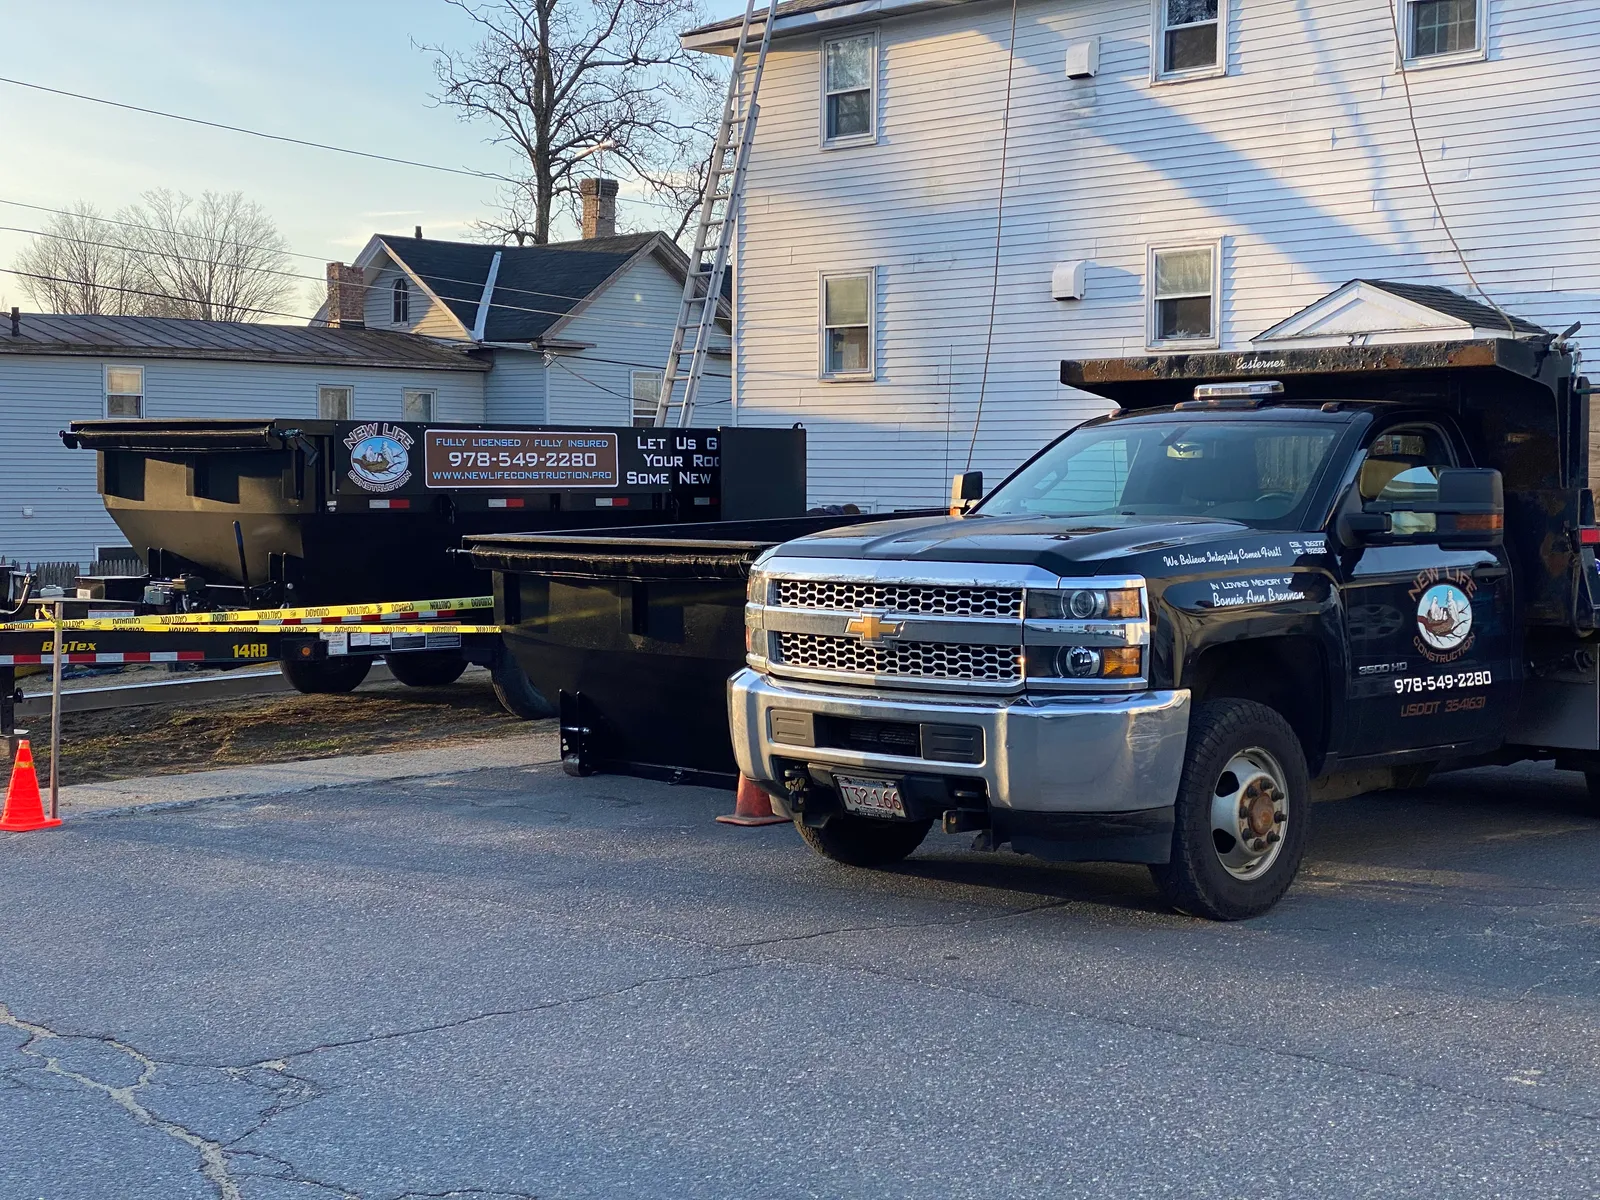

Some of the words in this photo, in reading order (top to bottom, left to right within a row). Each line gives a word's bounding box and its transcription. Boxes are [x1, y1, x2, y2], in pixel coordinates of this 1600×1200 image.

[1236, 356, 1286, 370] Easterner
[343, 422, 379, 451] NEW
[382, 423, 415, 451] LIFE
[435, 438, 467, 447] FULLY
[472, 439, 521, 447] LICENSED
[534, 439, 563, 448] FULLY
[567, 440, 609, 448] INSURED
[637, 436, 666, 450] LET
[448, 452, 597, 467] 978-549-2280
[643, 454, 684, 467] YOUR
[347, 470, 413, 493] CONSTRUCTION
[432, 471, 613, 480] WWW.NEWLIFECONSTRUCTION.PRO
[627, 471, 669, 485] SOME
[679, 471, 712, 485] NEW
[1163, 556, 1179, 567] We
[1180, 553, 1207, 566] Believe
[1207, 550, 1240, 565] Integrity
[1239, 548, 1262, 560] Comes
[1261, 546, 1283, 558] First!
[1210, 582, 1220, 591] IN
[1221, 581, 1250, 590] LOVING
[1251, 578, 1281, 587] MEMORY
[1283, 577, 1293, 585] OF
[1408, 568, 1439, 602] NEW
[1445, 566, 1478, 599] LIFE
[1213, 592, 1245, 608] Bonnie
[1246, 589, 1266, 604] Ann
[1267, 587, 1305, 602] Brennan
[41, 640, 97, 654] BgTex
[232, 643, 268, 658] 14RB
[1413, 631, 1476, 663] CONSTRUCTION
[1358, 663, 1390, 676] 3500
[1391, 661, 1408, 672] HD
[1394, 670, 1492, 694] 978-549-2280
[1400, 701, 1442, 718] USDOT
